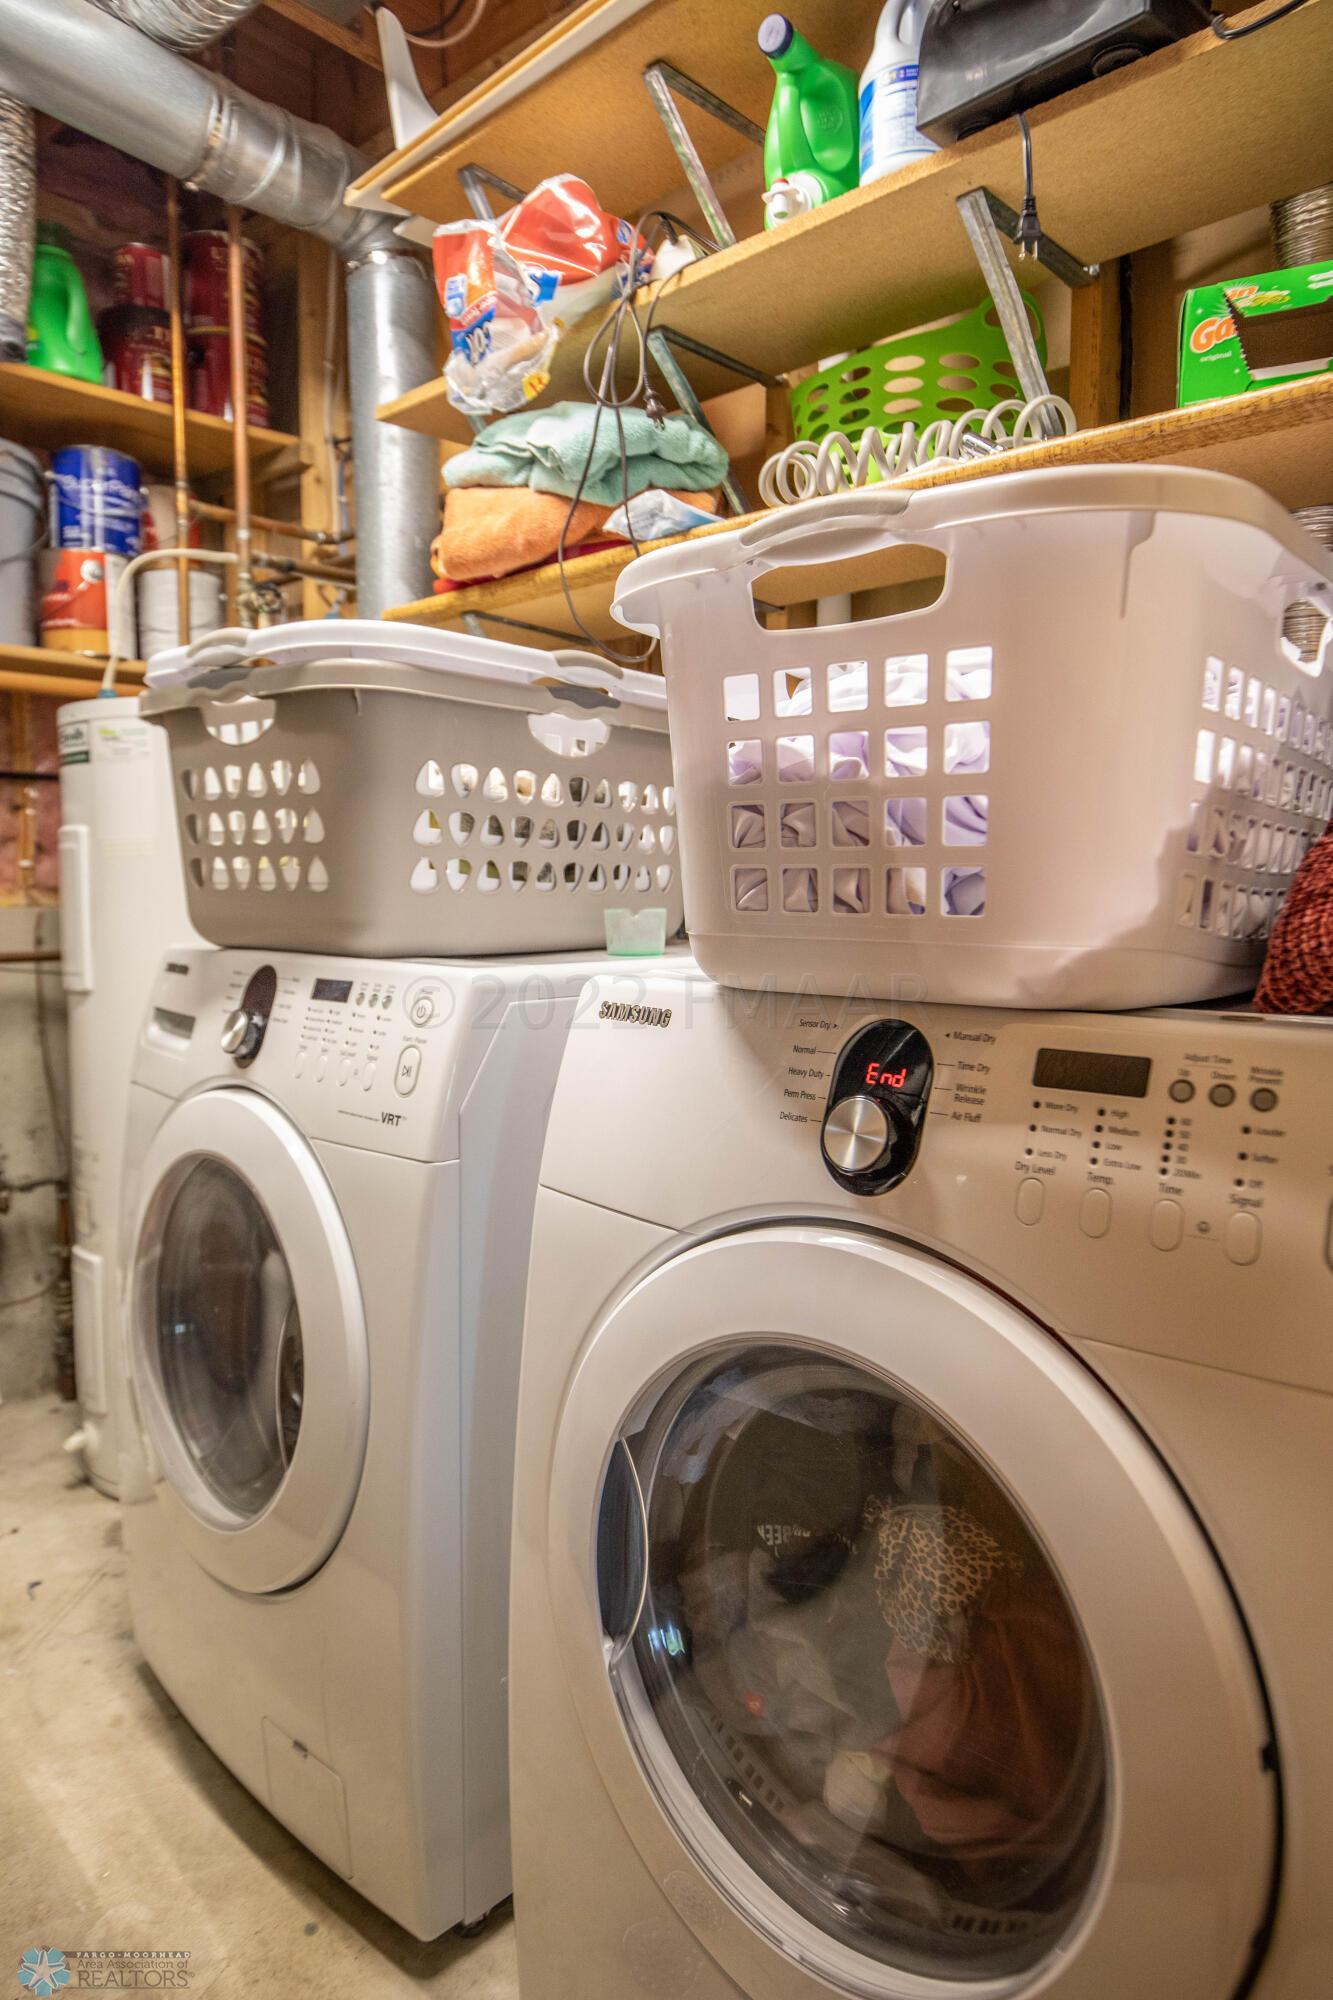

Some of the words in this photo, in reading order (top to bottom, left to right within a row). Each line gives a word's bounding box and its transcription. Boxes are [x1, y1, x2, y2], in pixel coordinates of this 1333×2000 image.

[1190, 314, 1239, 354] Ga
[1200, 351, 1232, 362] original
[599, 1001, 672, 1028] SAMSUNG
[800, 1019, 818, 1029] Sensor
[819, 1021, 831, 1031] Dry
[792, 1045, 817, 1055] Normal
[788, 1067, 807, 1079] Heavy
[808, 1068, 825, 1079] Duty
[957, 1061, 974, 1071] Time
[975, 1063, 991, 1074] Dry
[865, 1062, 907, 1088] End
[784, 1088, 799, 1099] Perm
[800, 1090, 816, 1101] Press
[381, 1111, 402, 1127] VRT
[779, 1111, 808, 1123] Delicates
[1015, 1161, 1030, 1174] Dry
[1032, 1164, 1057, 1176] Level
